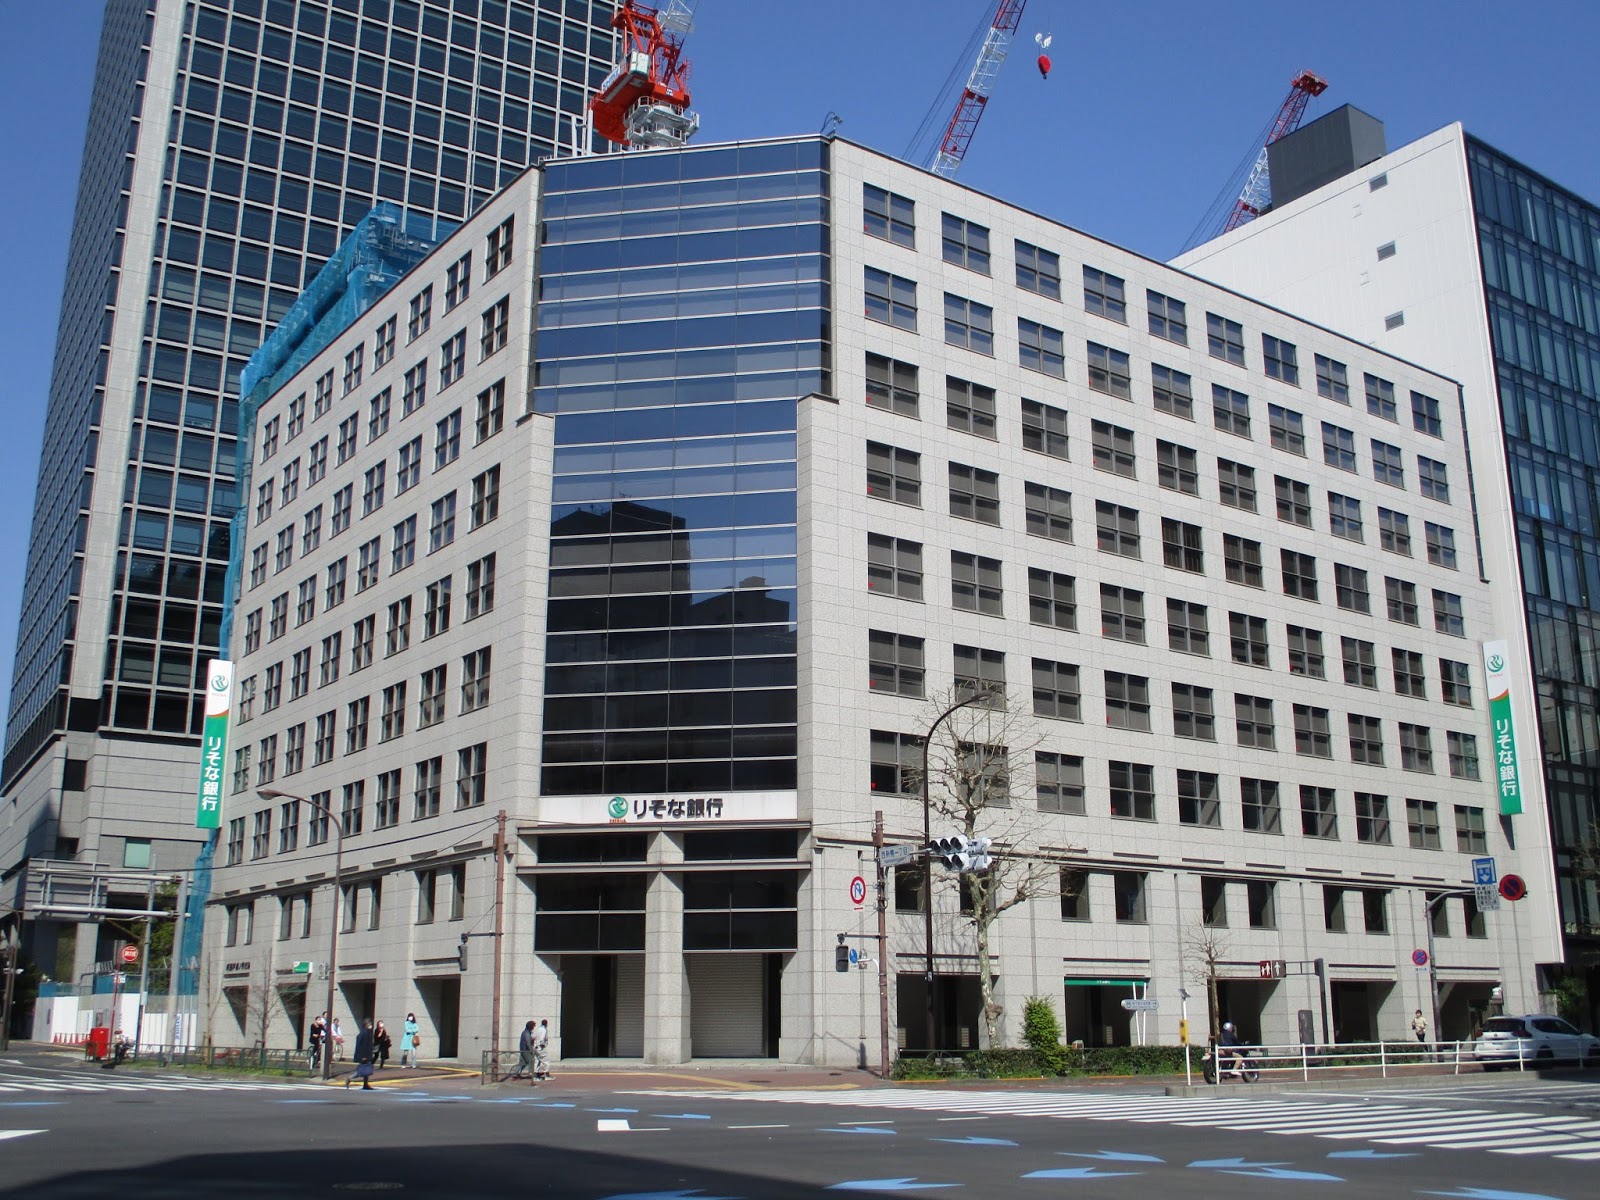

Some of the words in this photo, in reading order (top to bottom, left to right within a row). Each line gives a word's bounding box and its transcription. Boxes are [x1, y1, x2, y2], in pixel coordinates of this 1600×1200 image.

[201, 736, 221, 811] りそな銀行
[1496, 718, 1517, 797] りそな銀行
[633, 797, 723, 819] りそな銀行
